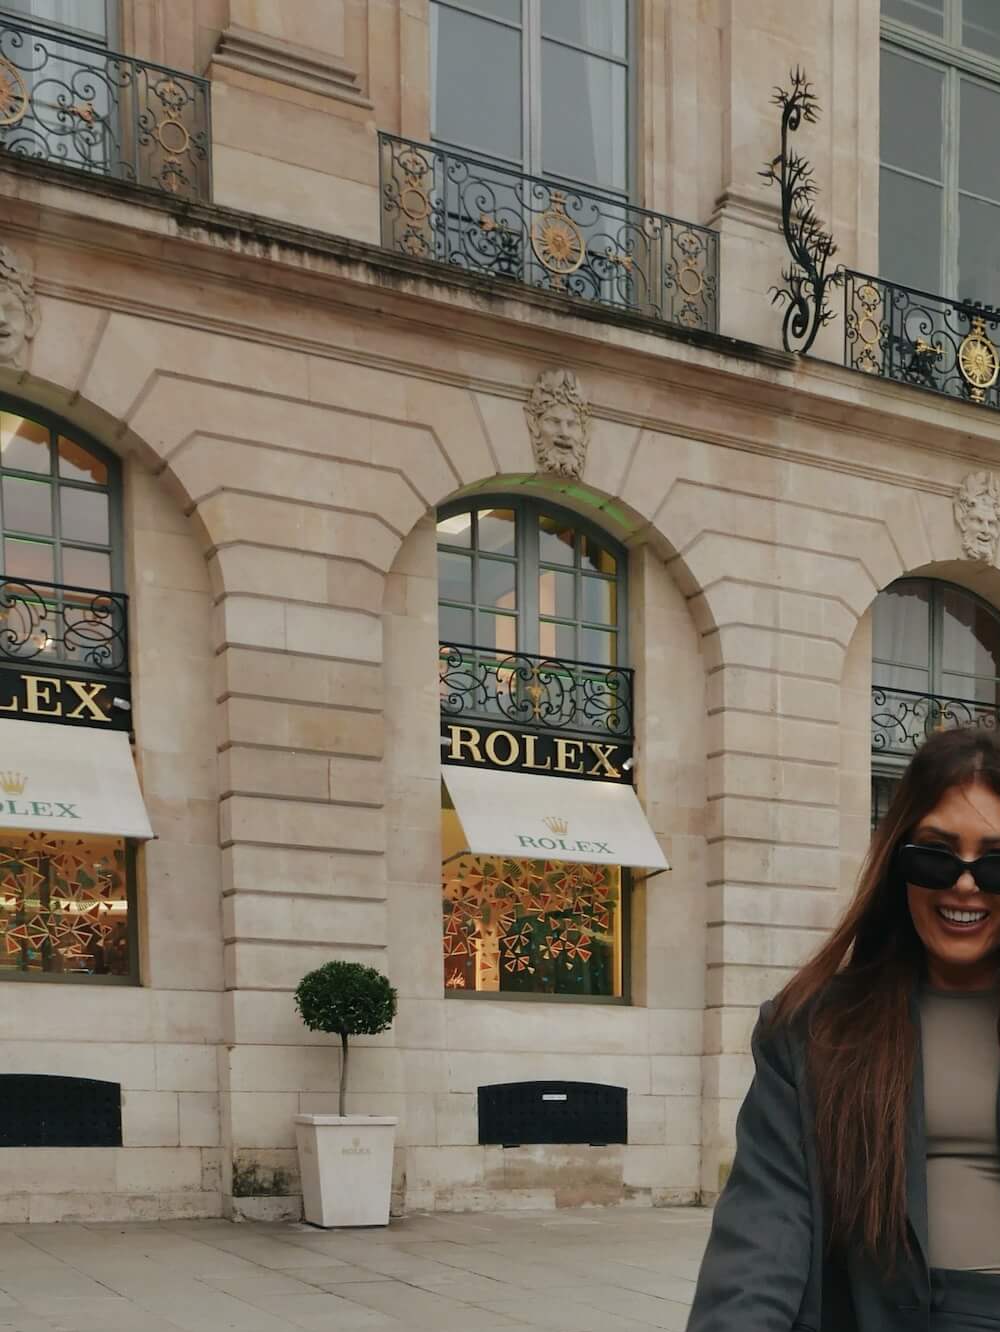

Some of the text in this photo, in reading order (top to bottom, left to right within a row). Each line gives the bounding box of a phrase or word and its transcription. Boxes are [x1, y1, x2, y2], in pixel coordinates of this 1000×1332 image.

[448, 725, 621, 777] ROLEX
[0, 800, 81, 819] LEX
[517, 835, 614, 854] ROLEX
